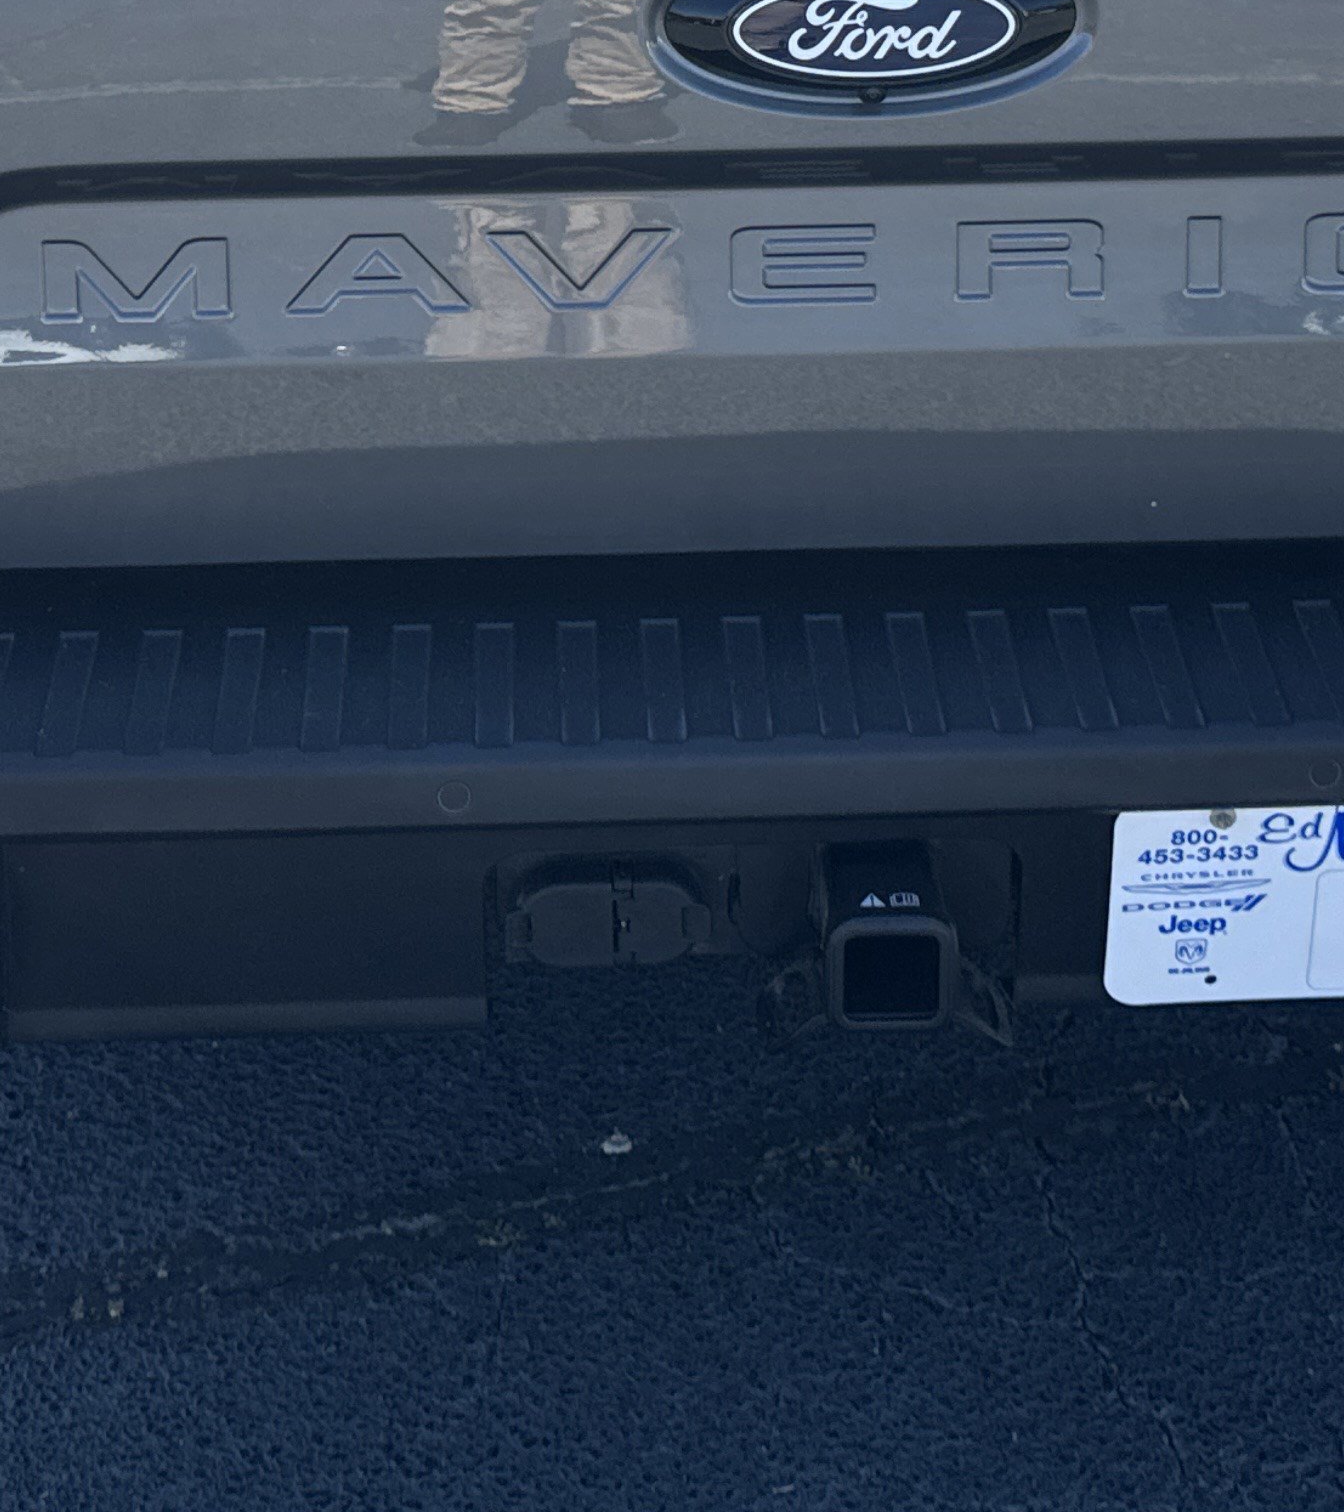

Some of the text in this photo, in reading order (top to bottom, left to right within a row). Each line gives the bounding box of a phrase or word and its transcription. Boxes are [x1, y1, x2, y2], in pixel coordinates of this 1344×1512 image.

[1170, 829, 1229, 846] 800-
[1257, 812, 1324, 843] Ed
[1137, 844, 1259, 865] 453-3433
[1140, 868, 1254, 882] CHRYSLER
[1158, 914, 1227, 935] Jeep
